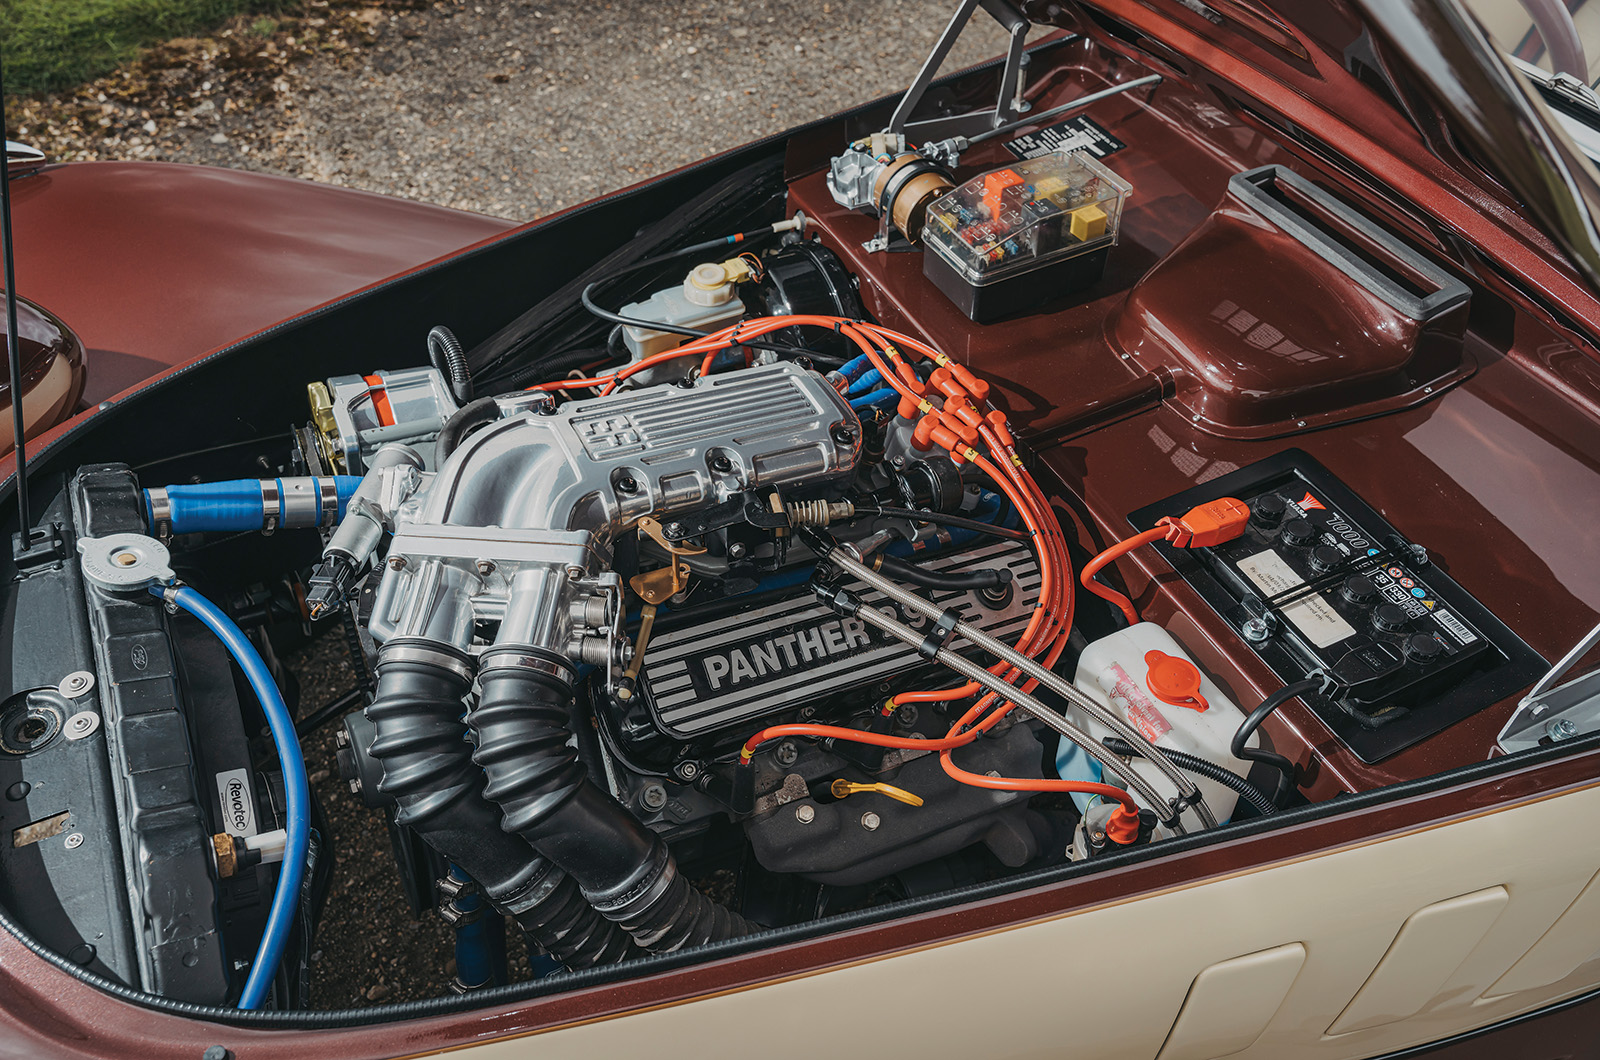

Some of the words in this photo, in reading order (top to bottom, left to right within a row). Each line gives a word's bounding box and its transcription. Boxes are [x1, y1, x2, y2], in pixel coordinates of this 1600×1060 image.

[1287, 498, 1308, 519] YUASA
[1375, 573, 1389, 584] 35
[1390, 586, 1407, 600] 330
[703, 617, 870, 690] PANTHER
[974, 693, 999, 714] MAGNECO
[1153, 720, 1164, 733] for
[229, 783, 246, 828] Revotec
